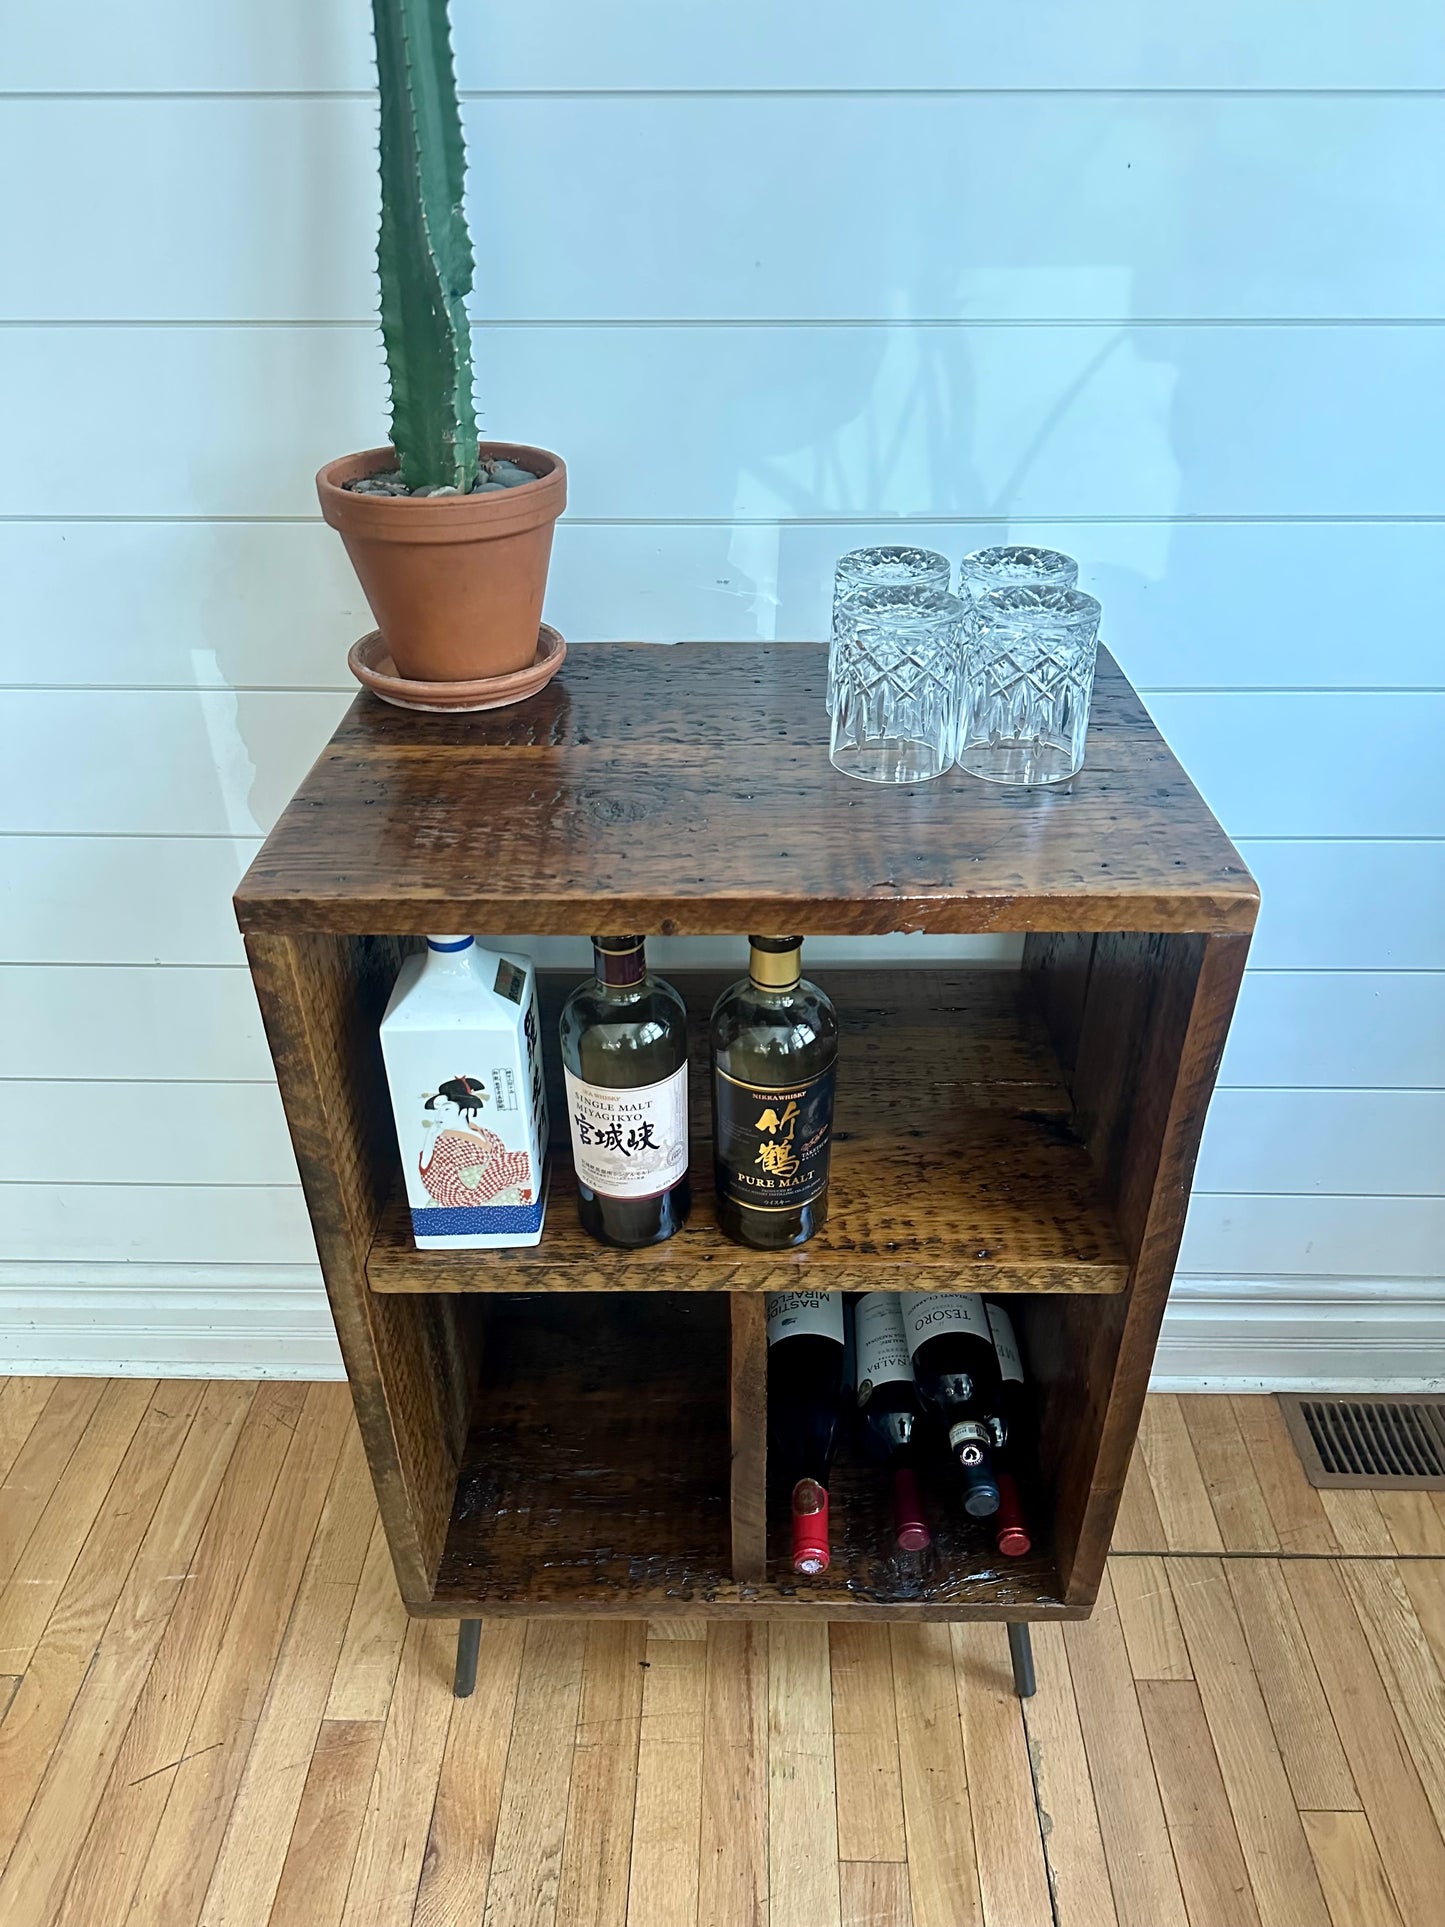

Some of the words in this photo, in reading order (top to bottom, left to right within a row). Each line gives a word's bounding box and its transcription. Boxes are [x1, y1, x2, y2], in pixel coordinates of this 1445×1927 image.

[575, 1092, 614, 1111] SINGLE
[619, 1101, 653, 1112] MALT
[576, 1103, 643, 1121] MIYAGIKYO
[574, 1113, 660, 1157] 宮城峡
[754, 1101, 801, 1178] 竹鶴
[738, 1172, 775, 1188] PURE
[779, 1170, 815, 1187] MALT
[915, 1309, 972, 1331] TESORO
